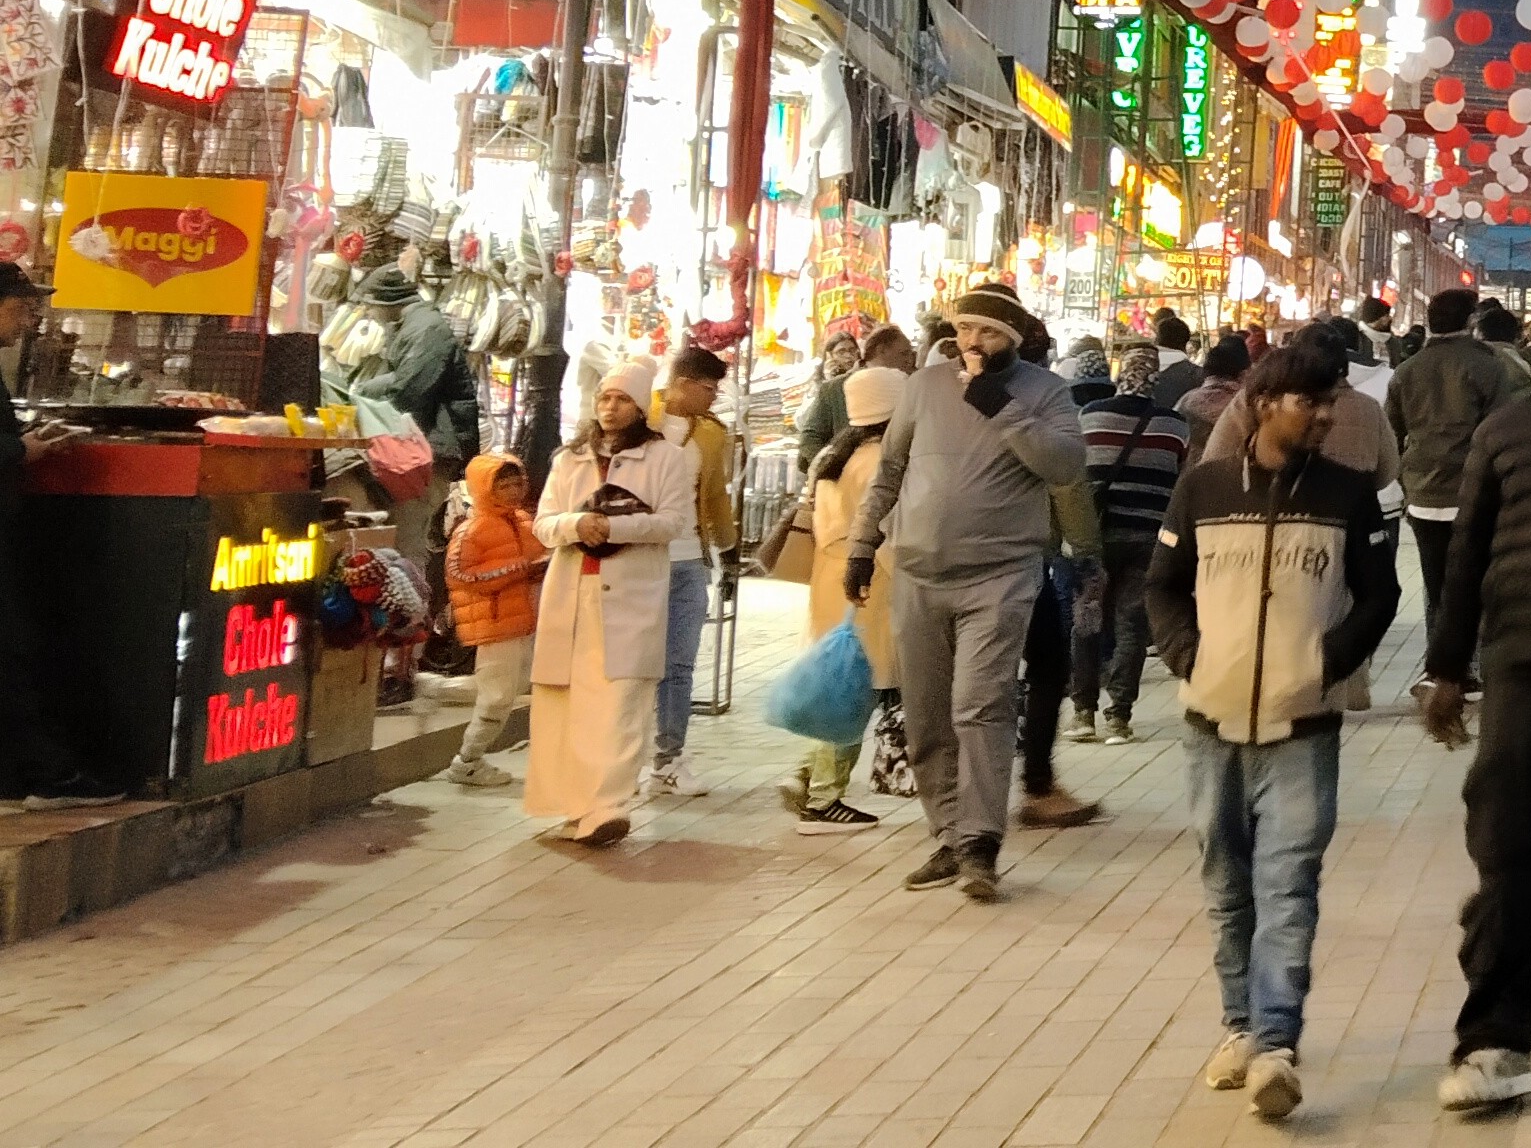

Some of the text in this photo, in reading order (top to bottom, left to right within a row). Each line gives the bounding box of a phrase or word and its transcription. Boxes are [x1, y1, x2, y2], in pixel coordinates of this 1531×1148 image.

[113, 17, 231, 101] Kulche
[102, 225, 217, 262] Maggi
[1069, 279, 1092, 295] 200
[223, 600, 298, 677] Chole
[204, 682, 298, 764] Kulche
